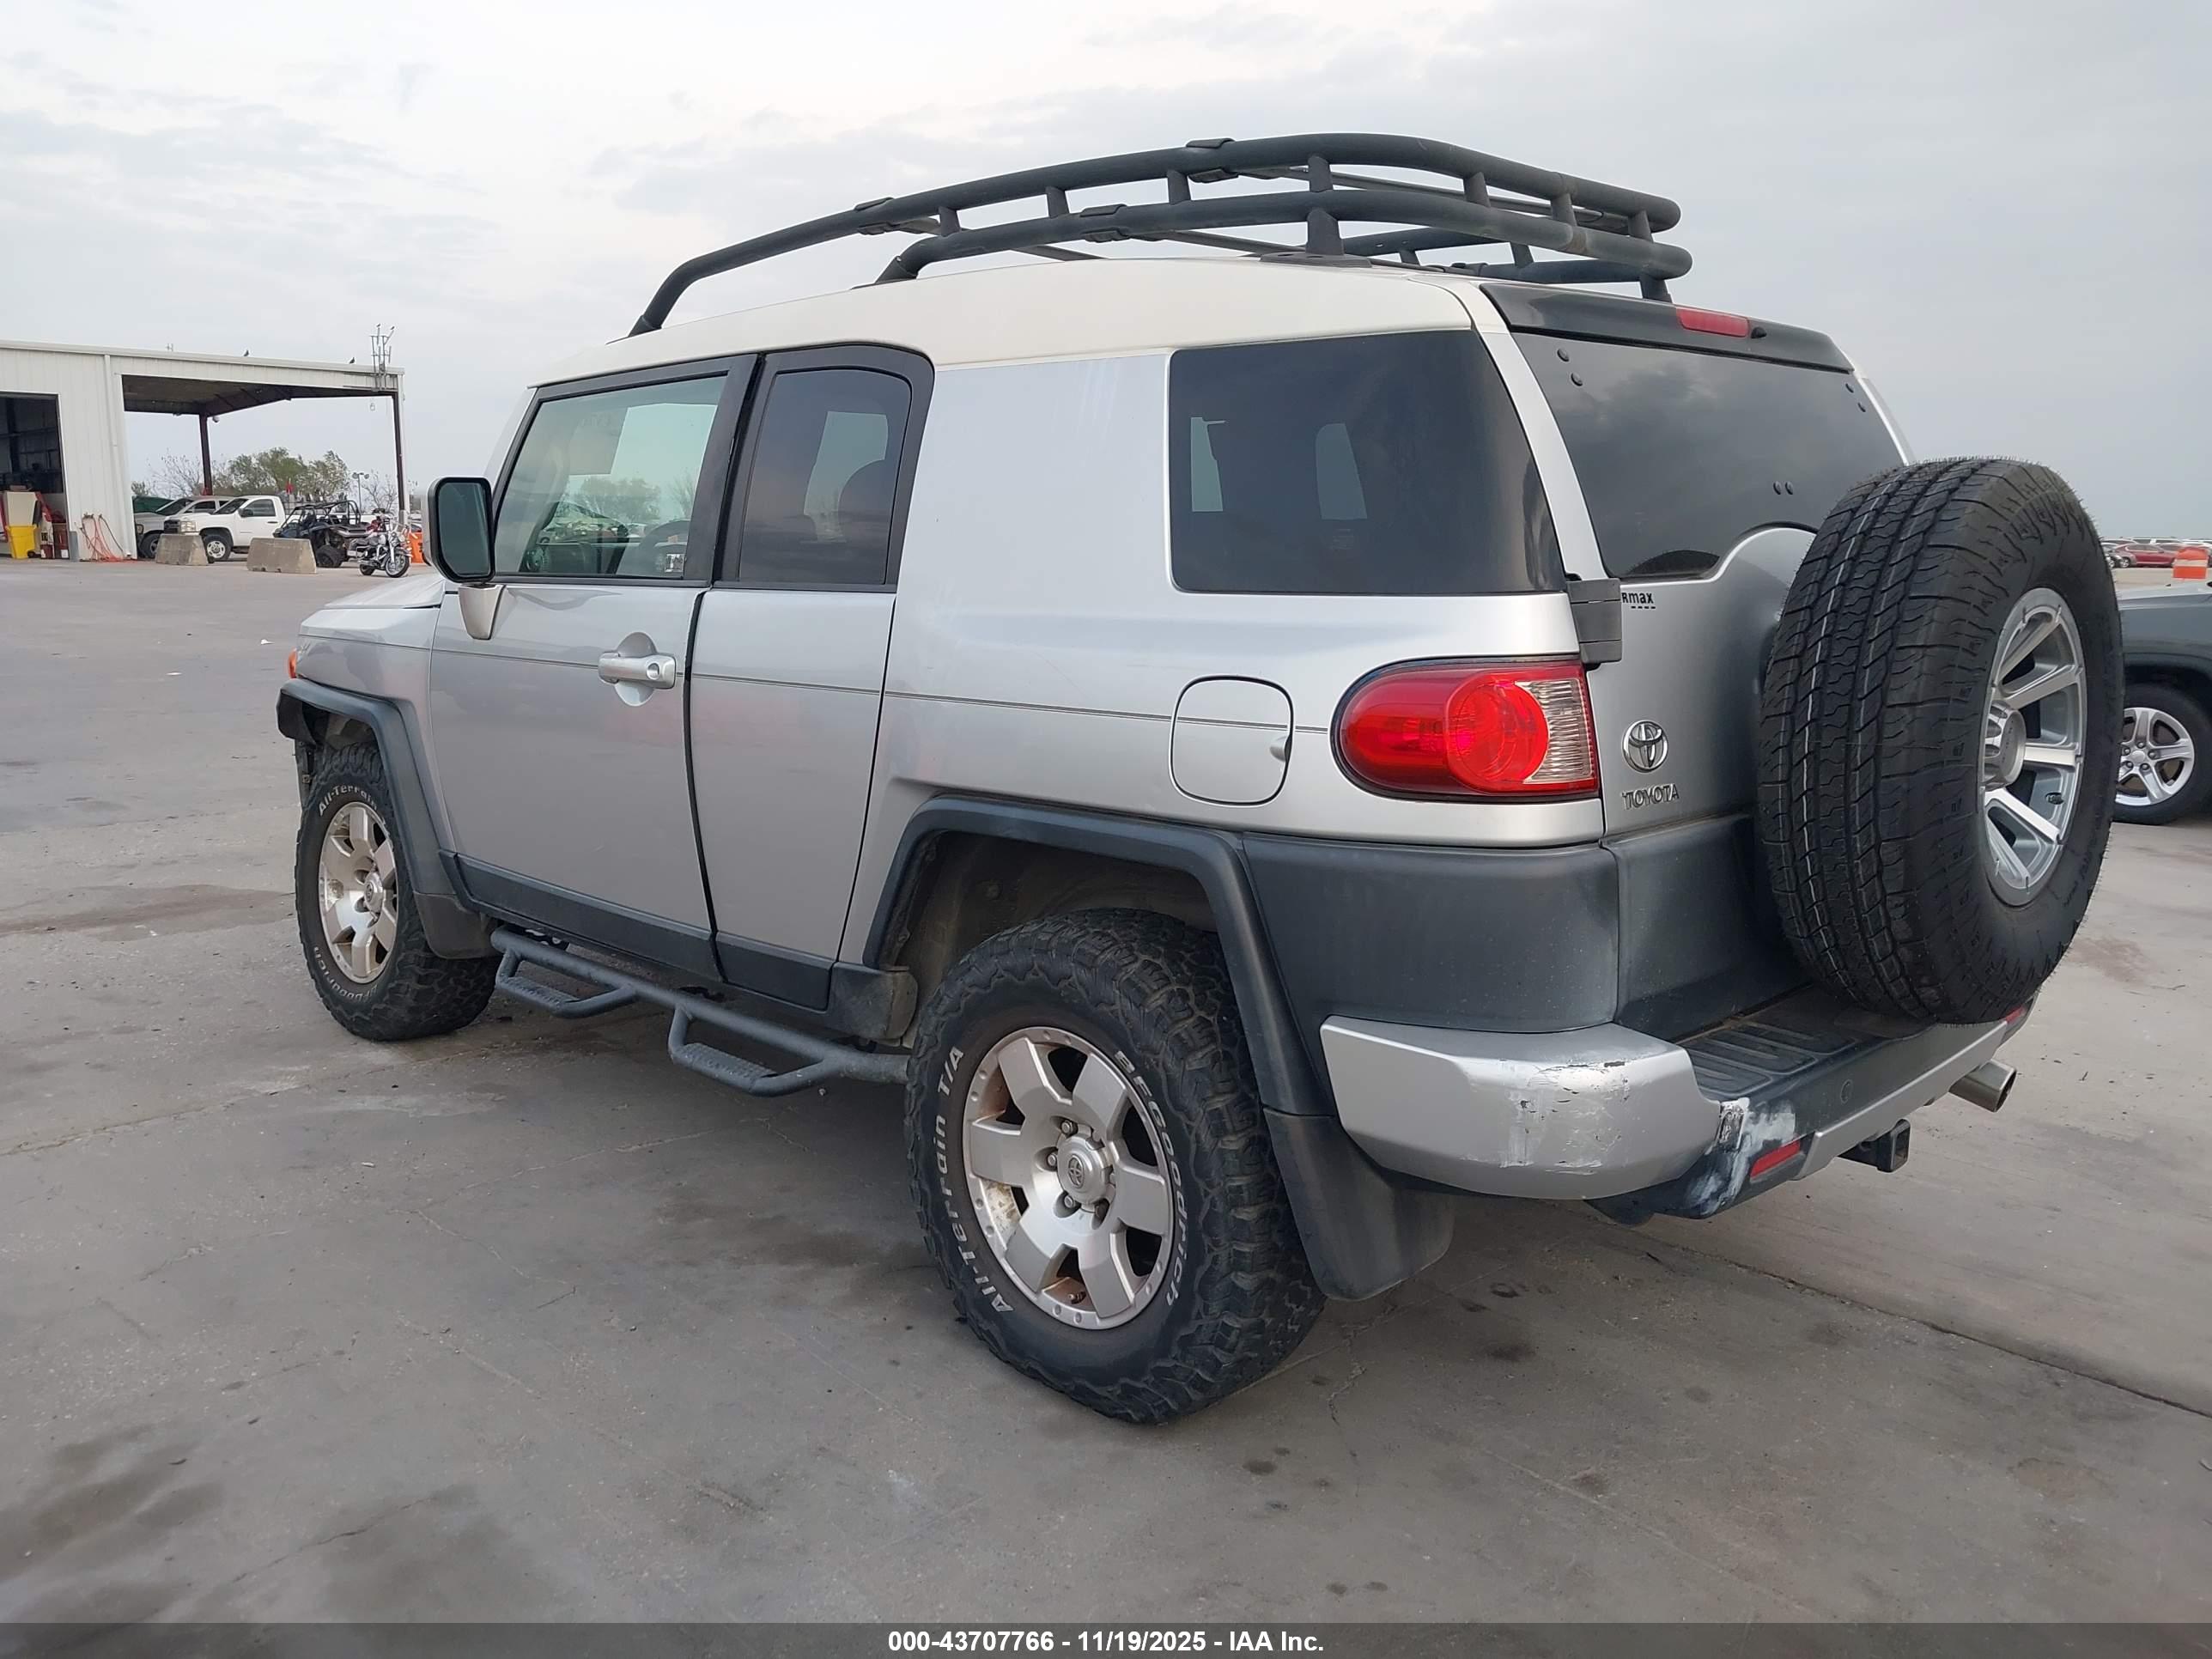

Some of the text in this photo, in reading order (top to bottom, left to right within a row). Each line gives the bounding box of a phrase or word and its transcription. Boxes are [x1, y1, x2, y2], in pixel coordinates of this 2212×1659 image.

[1621, 783, 1680, 810] TOYOTA
[933, 1046, 1014, 1312] All-Terrain T/A
[1115, 1050, 1188, 1306] BFGoodrich
